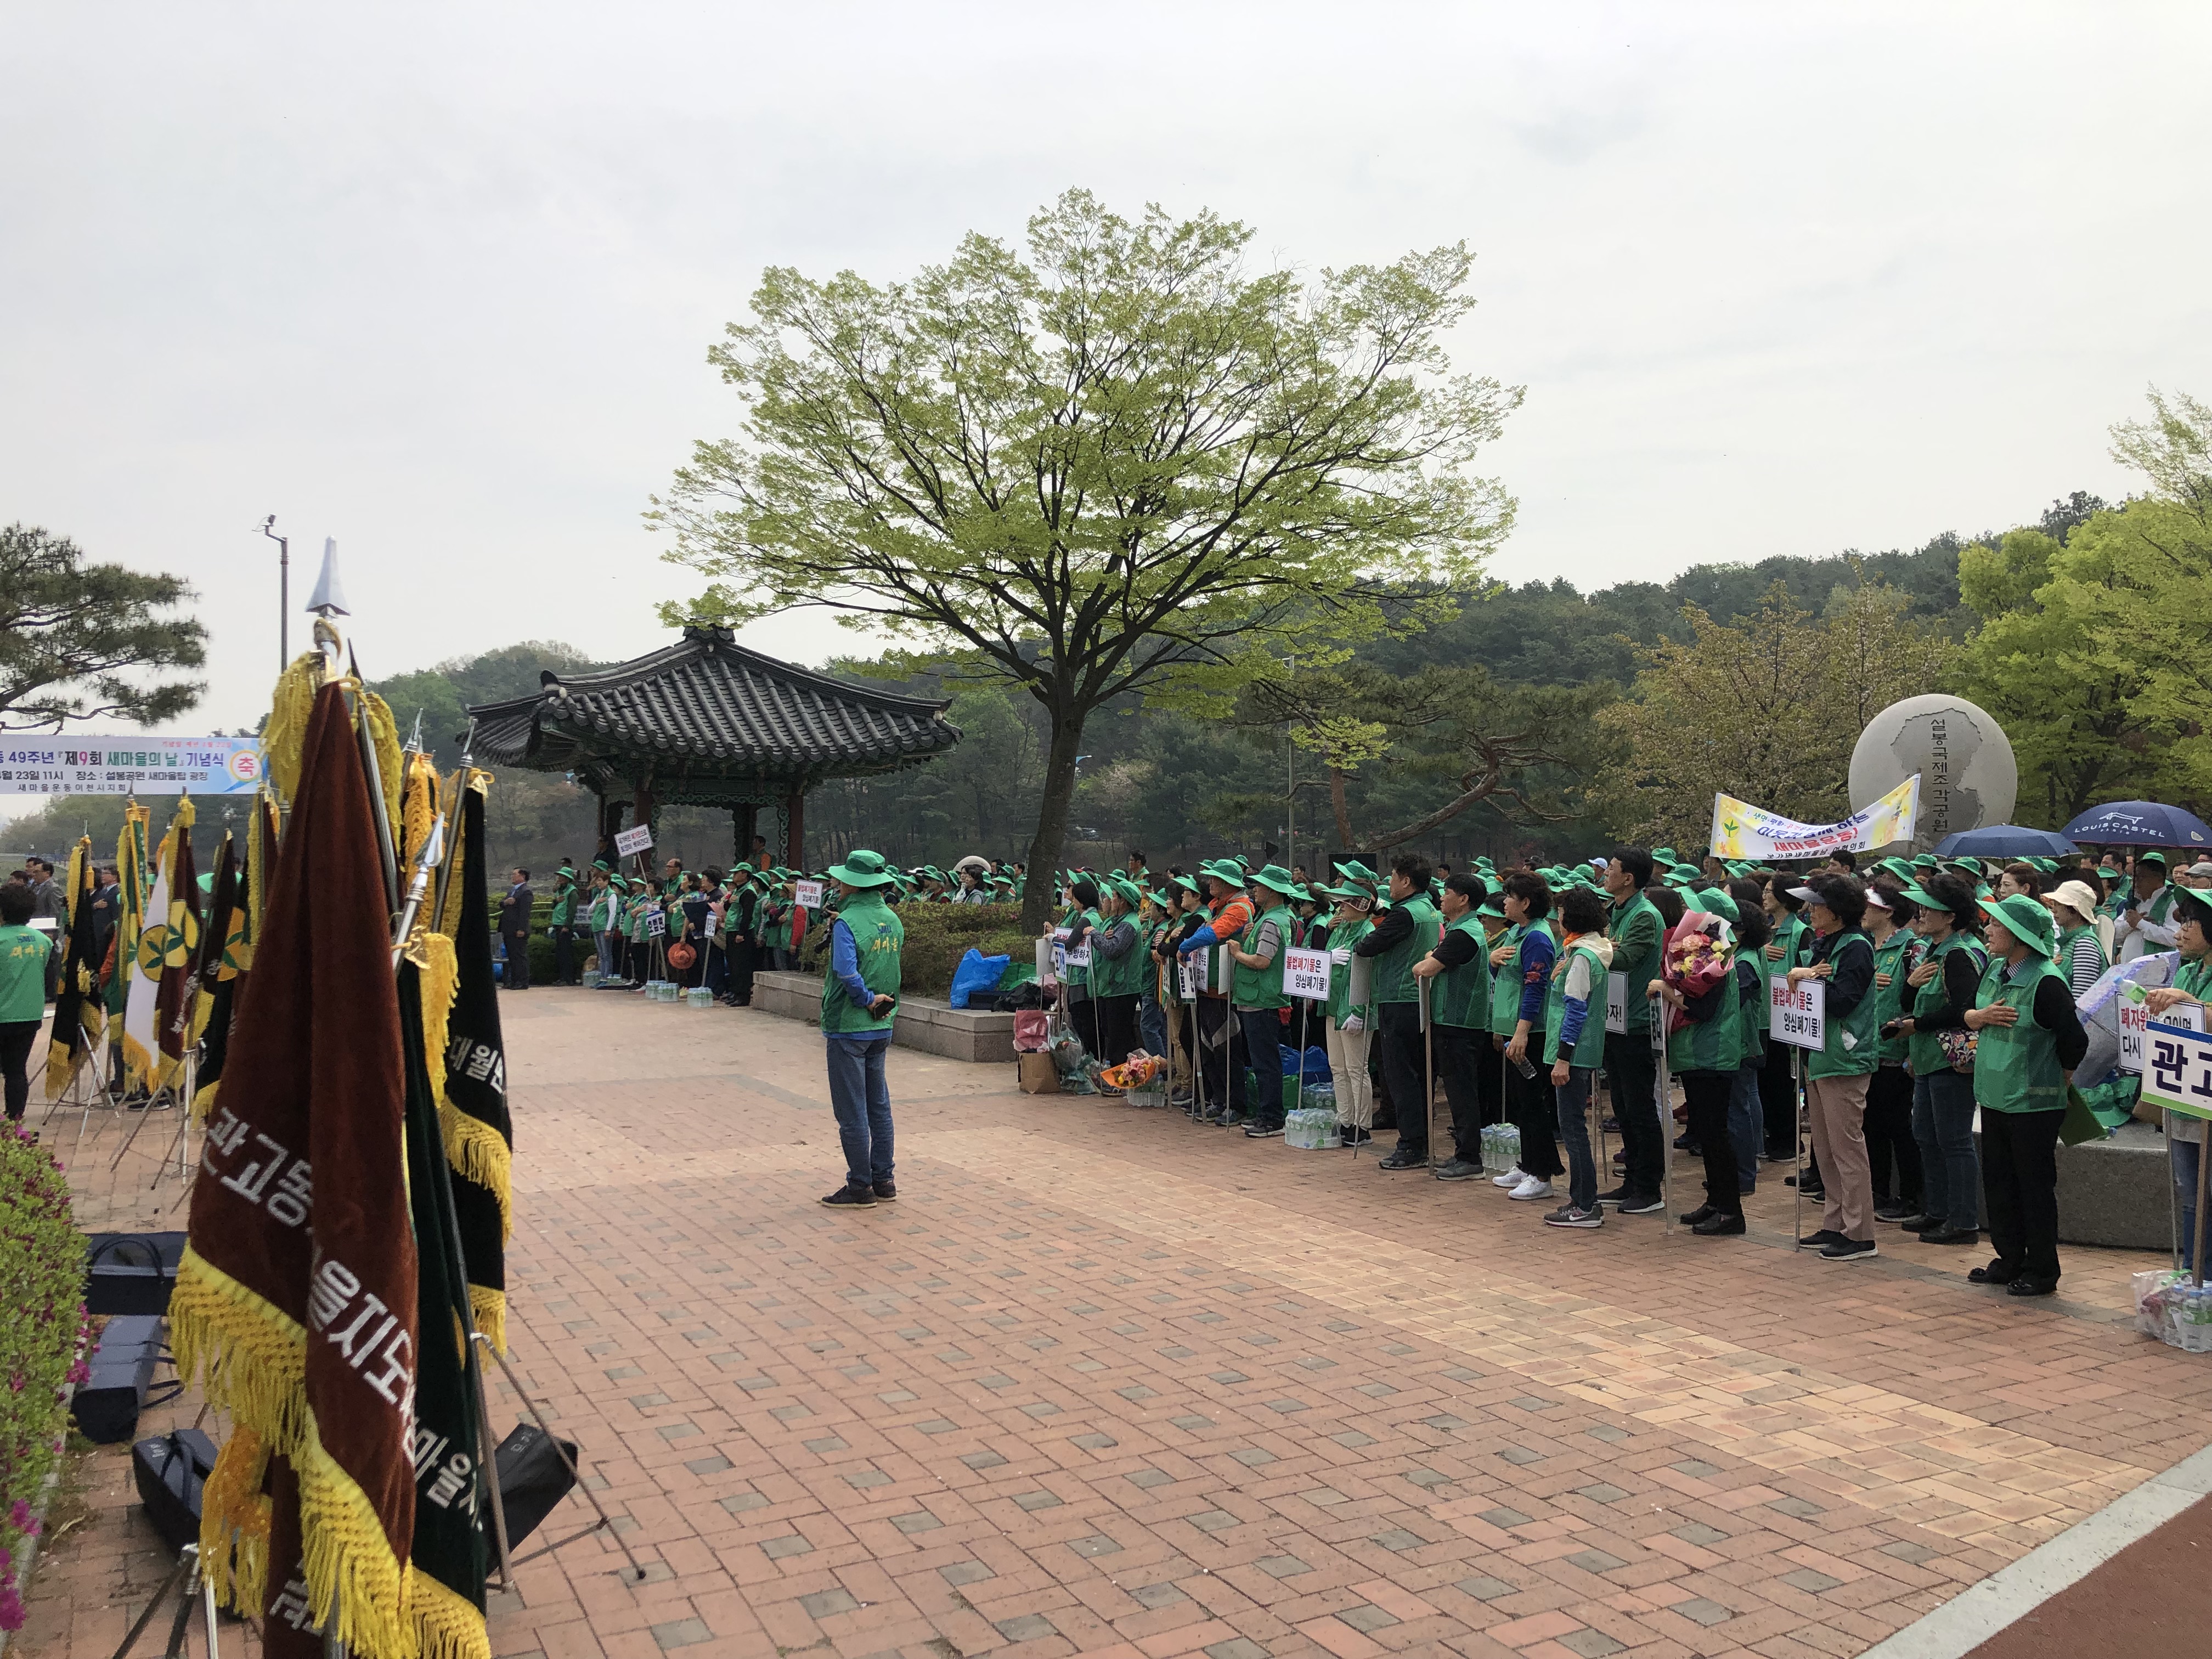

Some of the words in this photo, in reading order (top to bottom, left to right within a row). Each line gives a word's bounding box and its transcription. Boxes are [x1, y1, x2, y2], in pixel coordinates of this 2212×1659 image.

[107, 751, 161, 766] 새마을의
[238, 757, 255, 776] 축
[0, 770, 12, 780] 월
[15, 771, 40, 780] 23일
[43, 771, 64, 780] 11시
[105, 771, 145, 781] 설봉공원
[148, 771, 187, 781] 새마을탑
[190, 772, 208, 781] 광장
[1931, 719, 1949, 833] 설봉국제조각공원
[2074, 822, 2109, 833] LOUIS
[2112, 822, 2165, 838] CASTEL
[1773, 827, 1858, 852] 새마을운동!
[1286, 955, 1322, 973] 불법폐기물은
[1295, 974, 1327, 992] 양심폐기물!
[1772, 986, 1813, 1012] 불법폐기물은
[1784, 1012, 1820, 1039] 양심폐기물!
